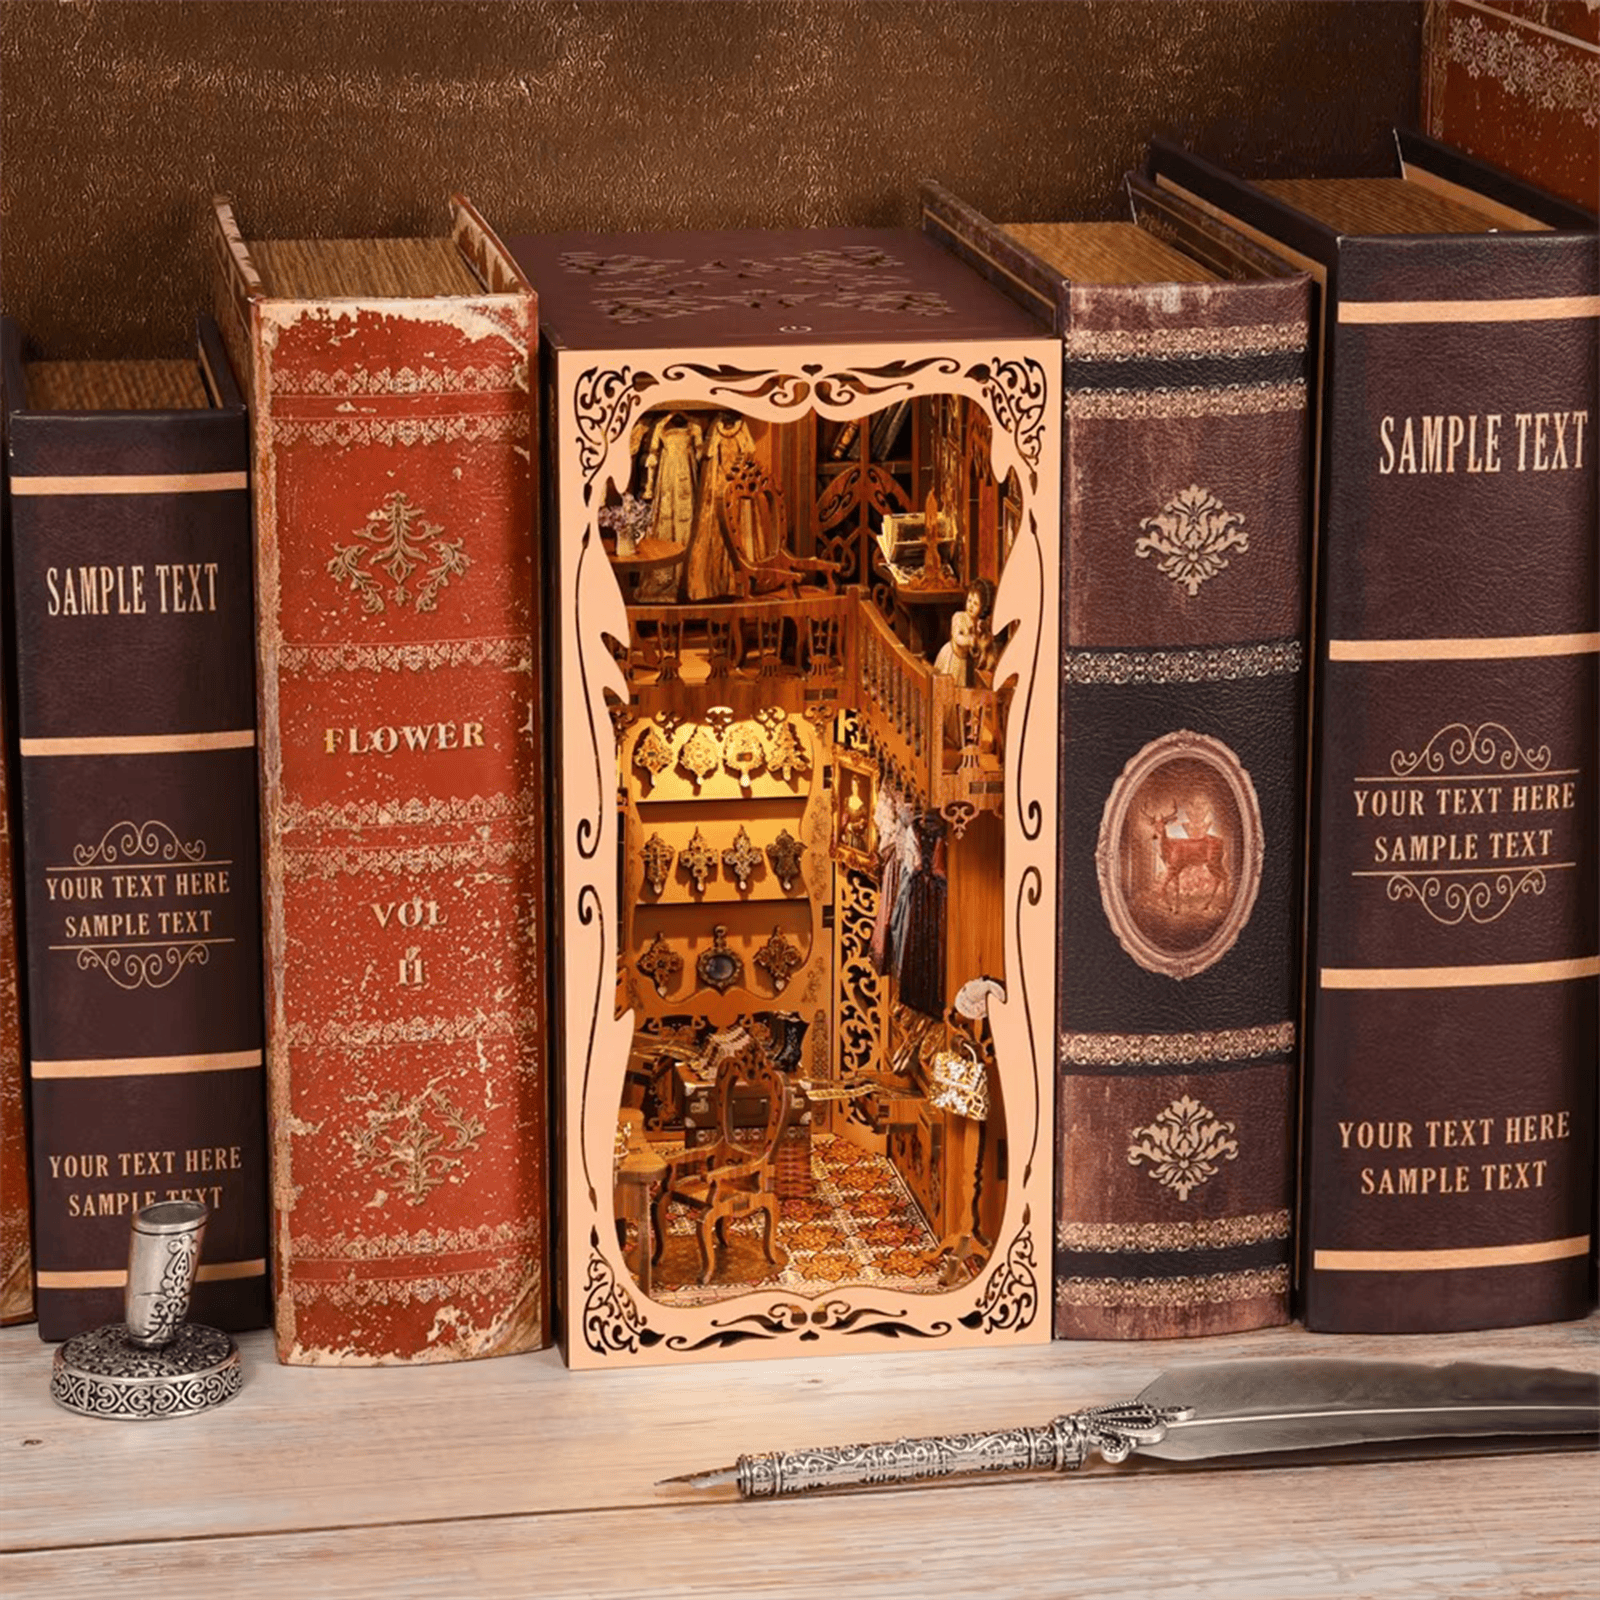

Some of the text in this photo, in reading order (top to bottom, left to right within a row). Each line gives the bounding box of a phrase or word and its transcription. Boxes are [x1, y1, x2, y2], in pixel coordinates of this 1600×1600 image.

[1379, 409, 1589, 475] SAMPLE TEXT
[46, 563, 219, 616] SAMPLE TEXT
[324, 721, 485, 755] FLOWER
[1353, 782, 1576, 817] YOUR TEXT HERE
[1374, 828, 1554, 863] SAMPLE TEXT
[46, 871, 231, 901] YOUR TEXT HERE
[65, 910, 213, 939] SAMPLE TEXT
[369, 900, 450, 929] VOL
[1338, 1111, 1570, 1149] YOUR TEXT HERE
[49, 1146, 242, 1179] YOUR TEXT HERE
[1361, 1160, 1548, 1195] SAMPLE TEXT
